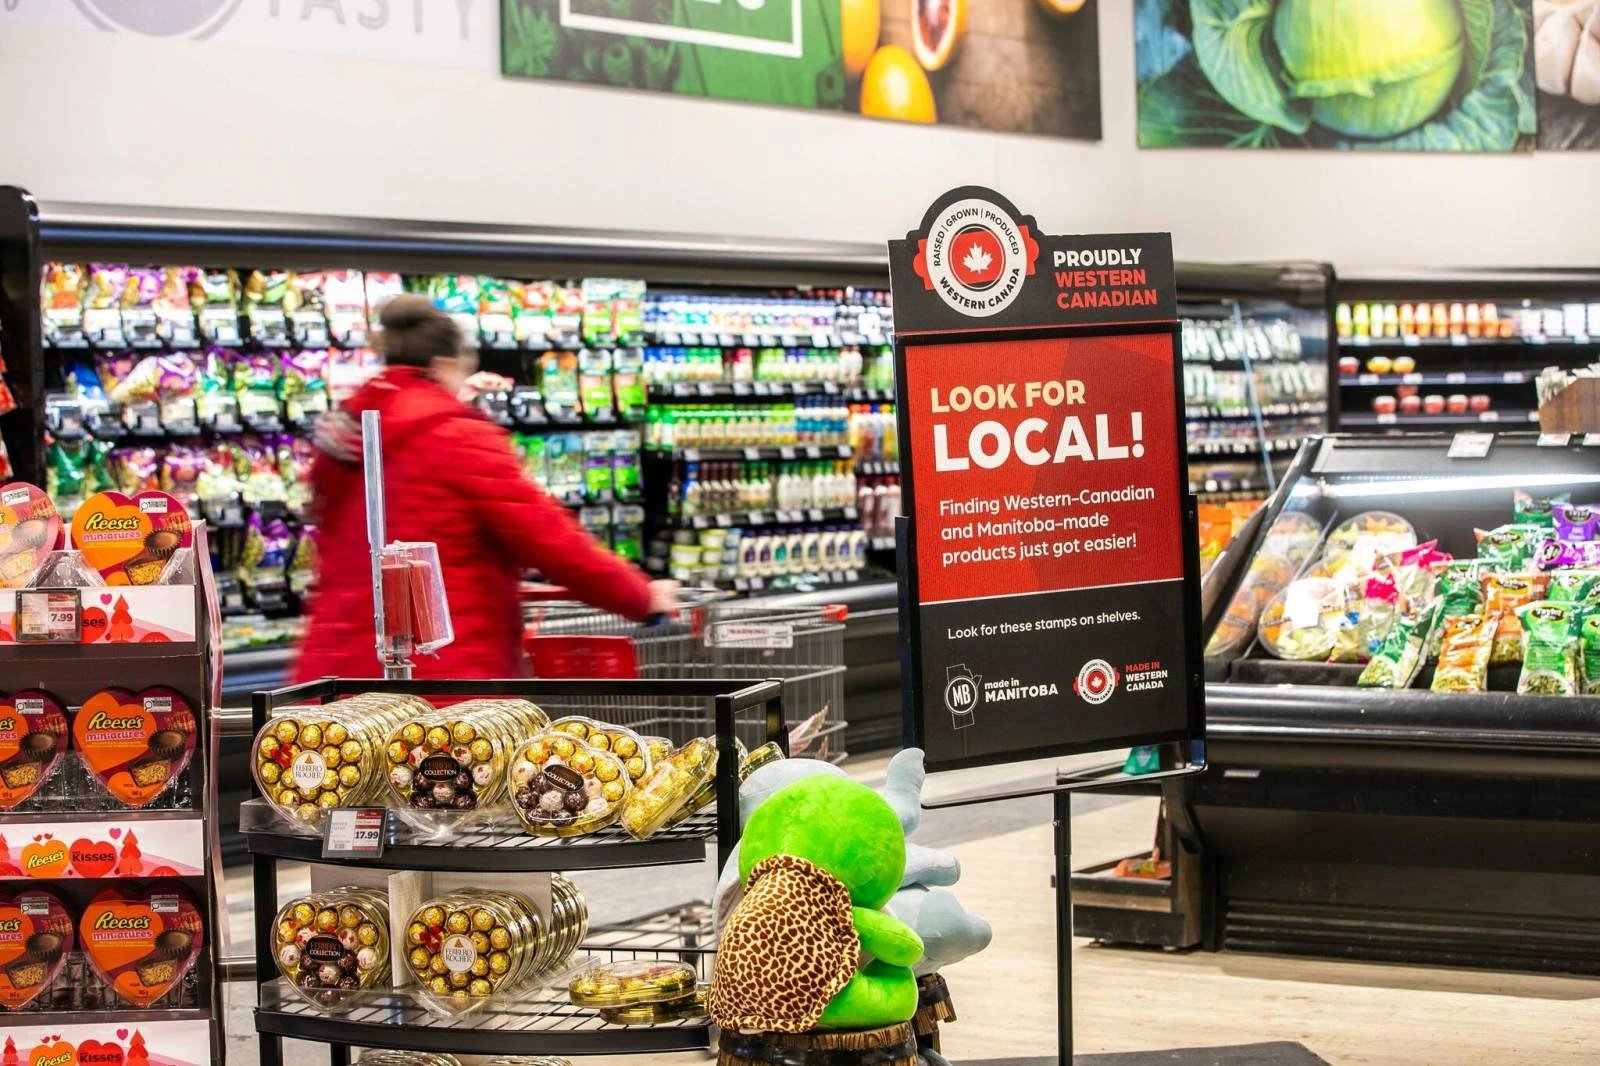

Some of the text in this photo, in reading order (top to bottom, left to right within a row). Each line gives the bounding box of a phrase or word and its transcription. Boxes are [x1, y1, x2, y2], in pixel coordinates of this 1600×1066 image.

[934, 208, 1020, 266] RAISED GROWN PRODUCED
[1053, 248, 1142, 268] PROUDLY
[1054, 268, 1146, 288] WESTERN
[940, 268, 1020, 310] WESTERN CANADA
[1056, 288, 1158, 310] CANADIAN
[930, 380, 1086, 414] LOOK FOR
[932, 411, 1145, 472] LOCAL!
[939, 485, 1155, 516] Finding Western-Canadian
[84, 512, 140, 531] Reese's
[941, 512, 1110, 541] and Manitoba-made
[83, 532, 142, 542] miniatures
[942, 534, 1136, 568] products just got easier!
[50, 613, 73, 622] 7.99
[948, 610, 1142, 640] Look for these stamps on shelves.
[1126, 661, 1160, 672] MADE IN
[1126, 670, 1168, 682] WESTERN
[984, 678, 1020, 690] made in
[984, 683, 1058, 703] MANITOBA
[1126, 680, 1164, 692] CANADA
[952, 684, 971, 707] MB
[88, 712, 144, 730] Reese's
[86, 730, 144, 741] miniatures
[546, 771, 578, 790] COLLECTION
[355, 830, 378, 840] 17.99
[27, 850, 65, 869] Reese's
[94, 912, 152, 930] Reese's
[92, 930, 152, 941] miniatures
